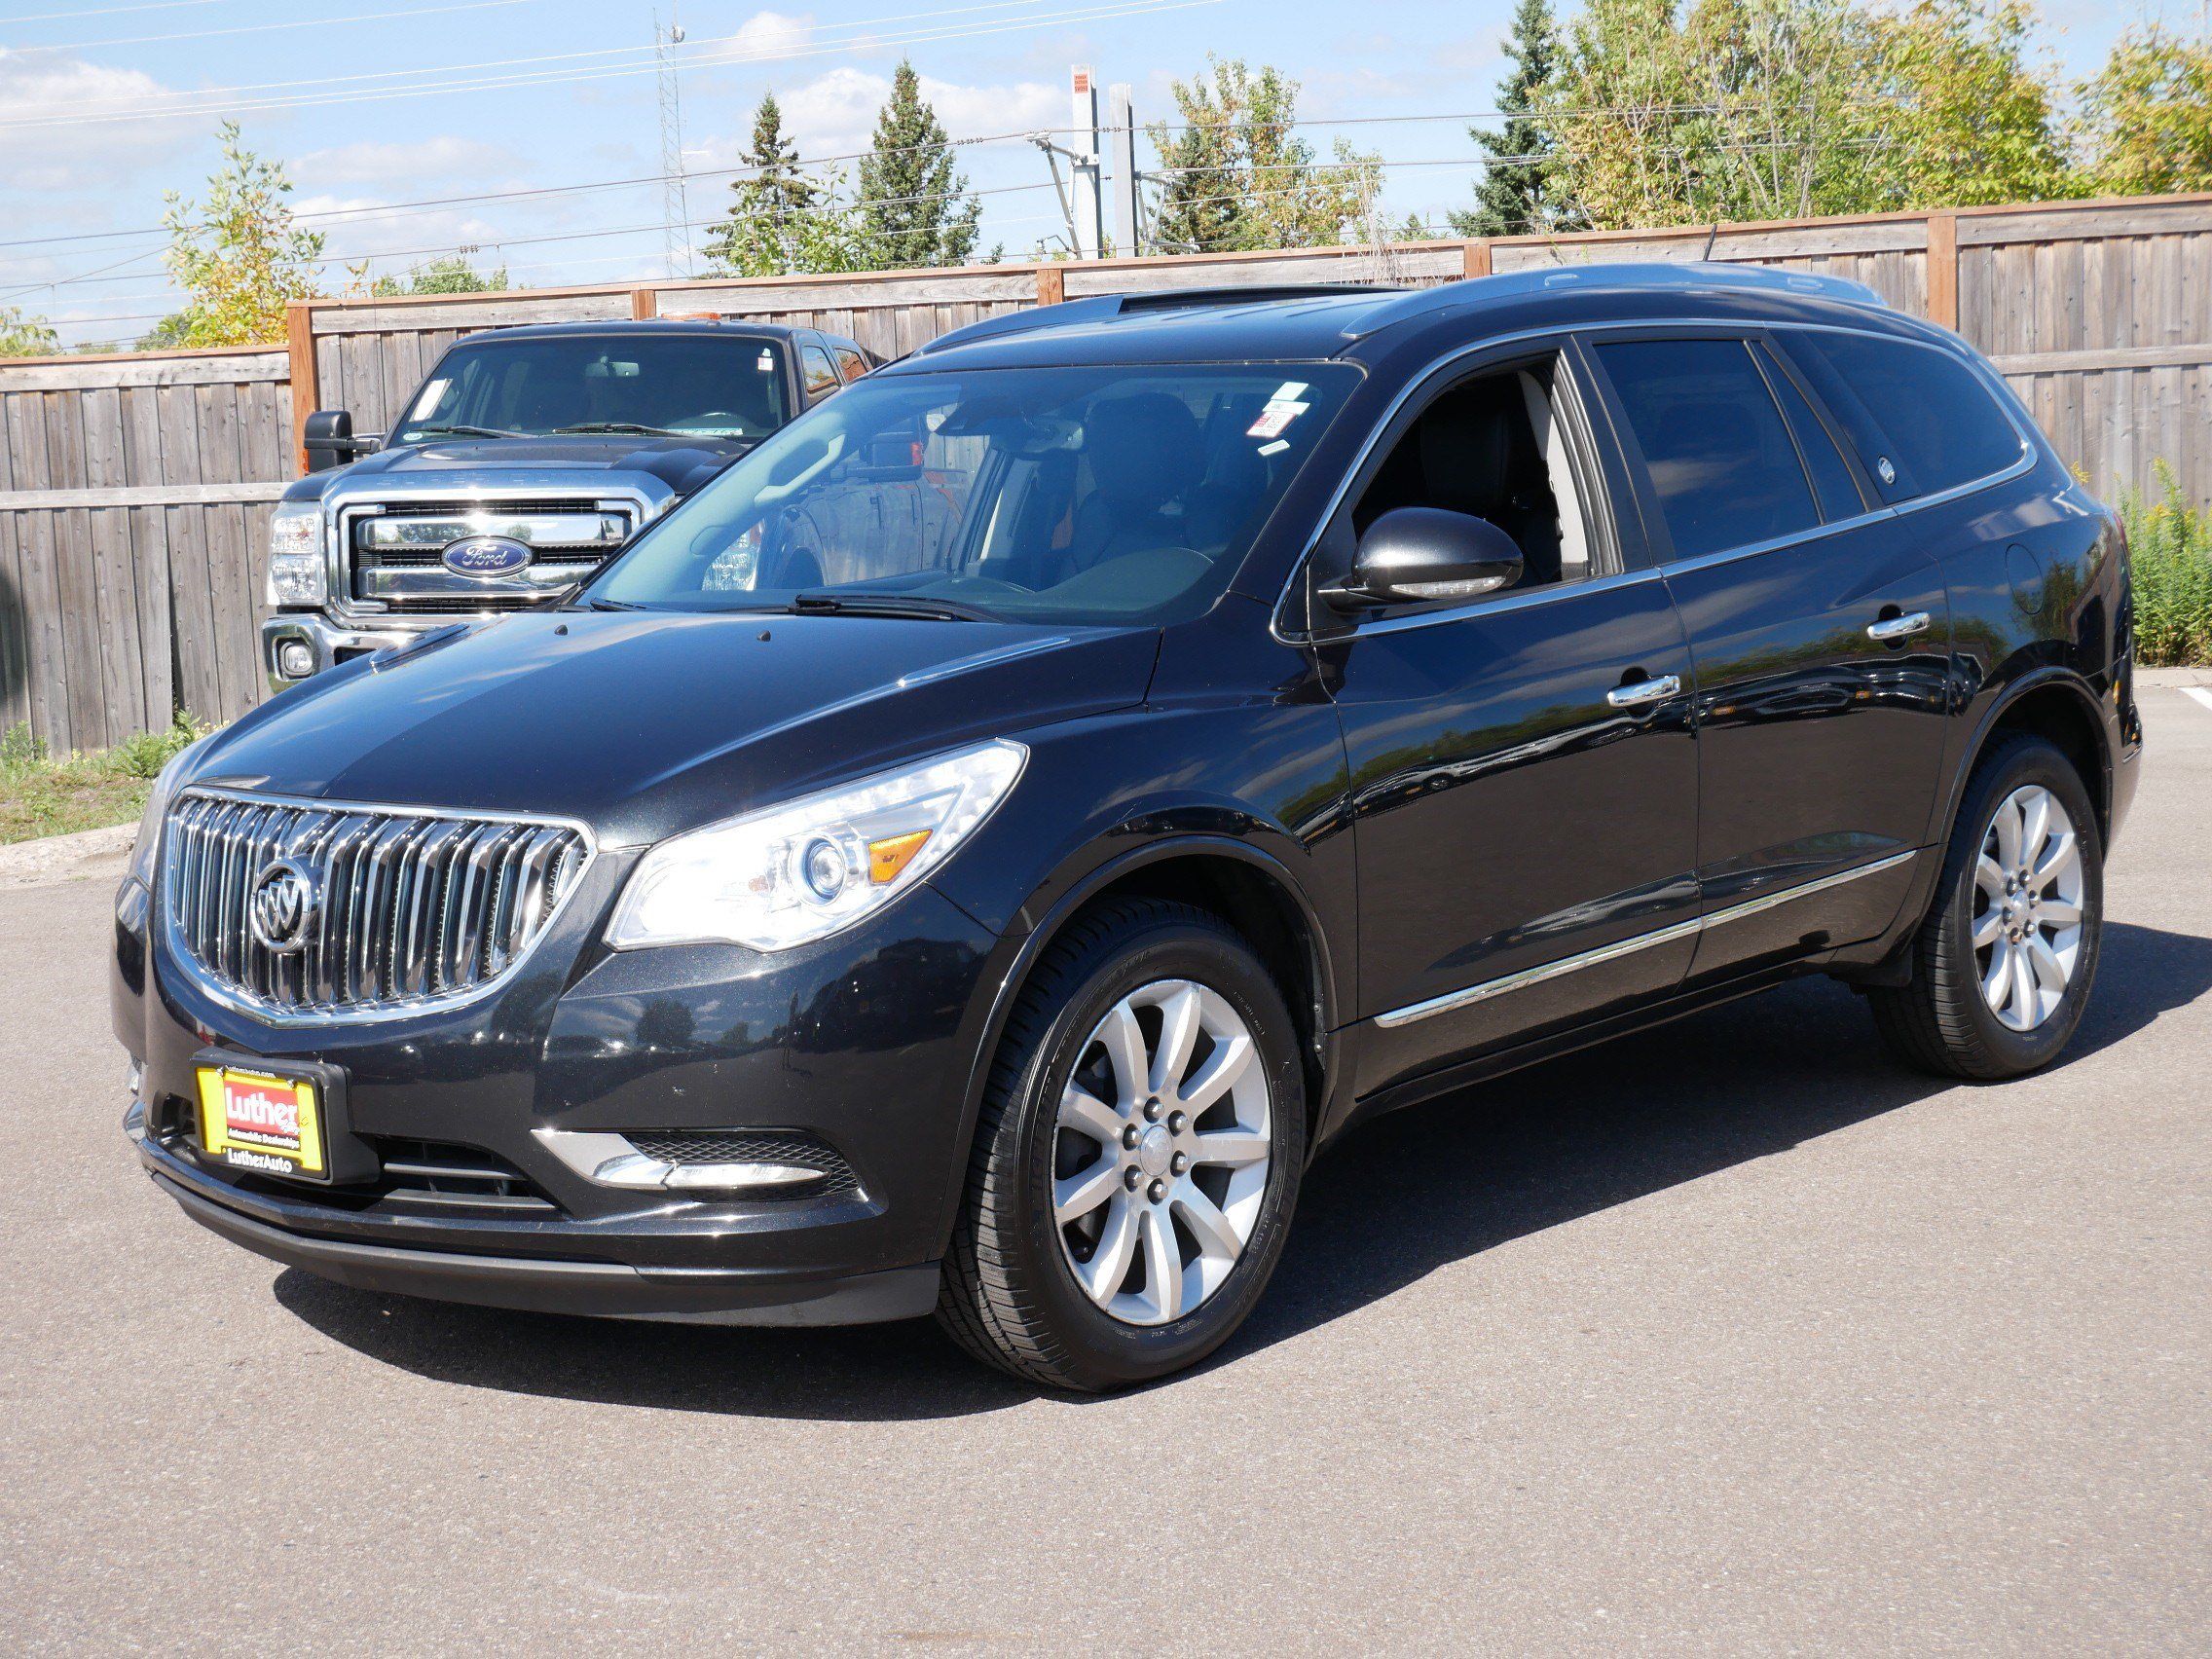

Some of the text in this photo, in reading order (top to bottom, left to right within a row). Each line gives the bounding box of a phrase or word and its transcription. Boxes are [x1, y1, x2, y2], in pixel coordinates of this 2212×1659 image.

[462, 544, 507, 566] Ford
[225, 1087, 298, 1126] Luther
[228, 1128, 300, 1149] Automobile Dealerships
[227, 1148, 293, 1173] LutherAuto
